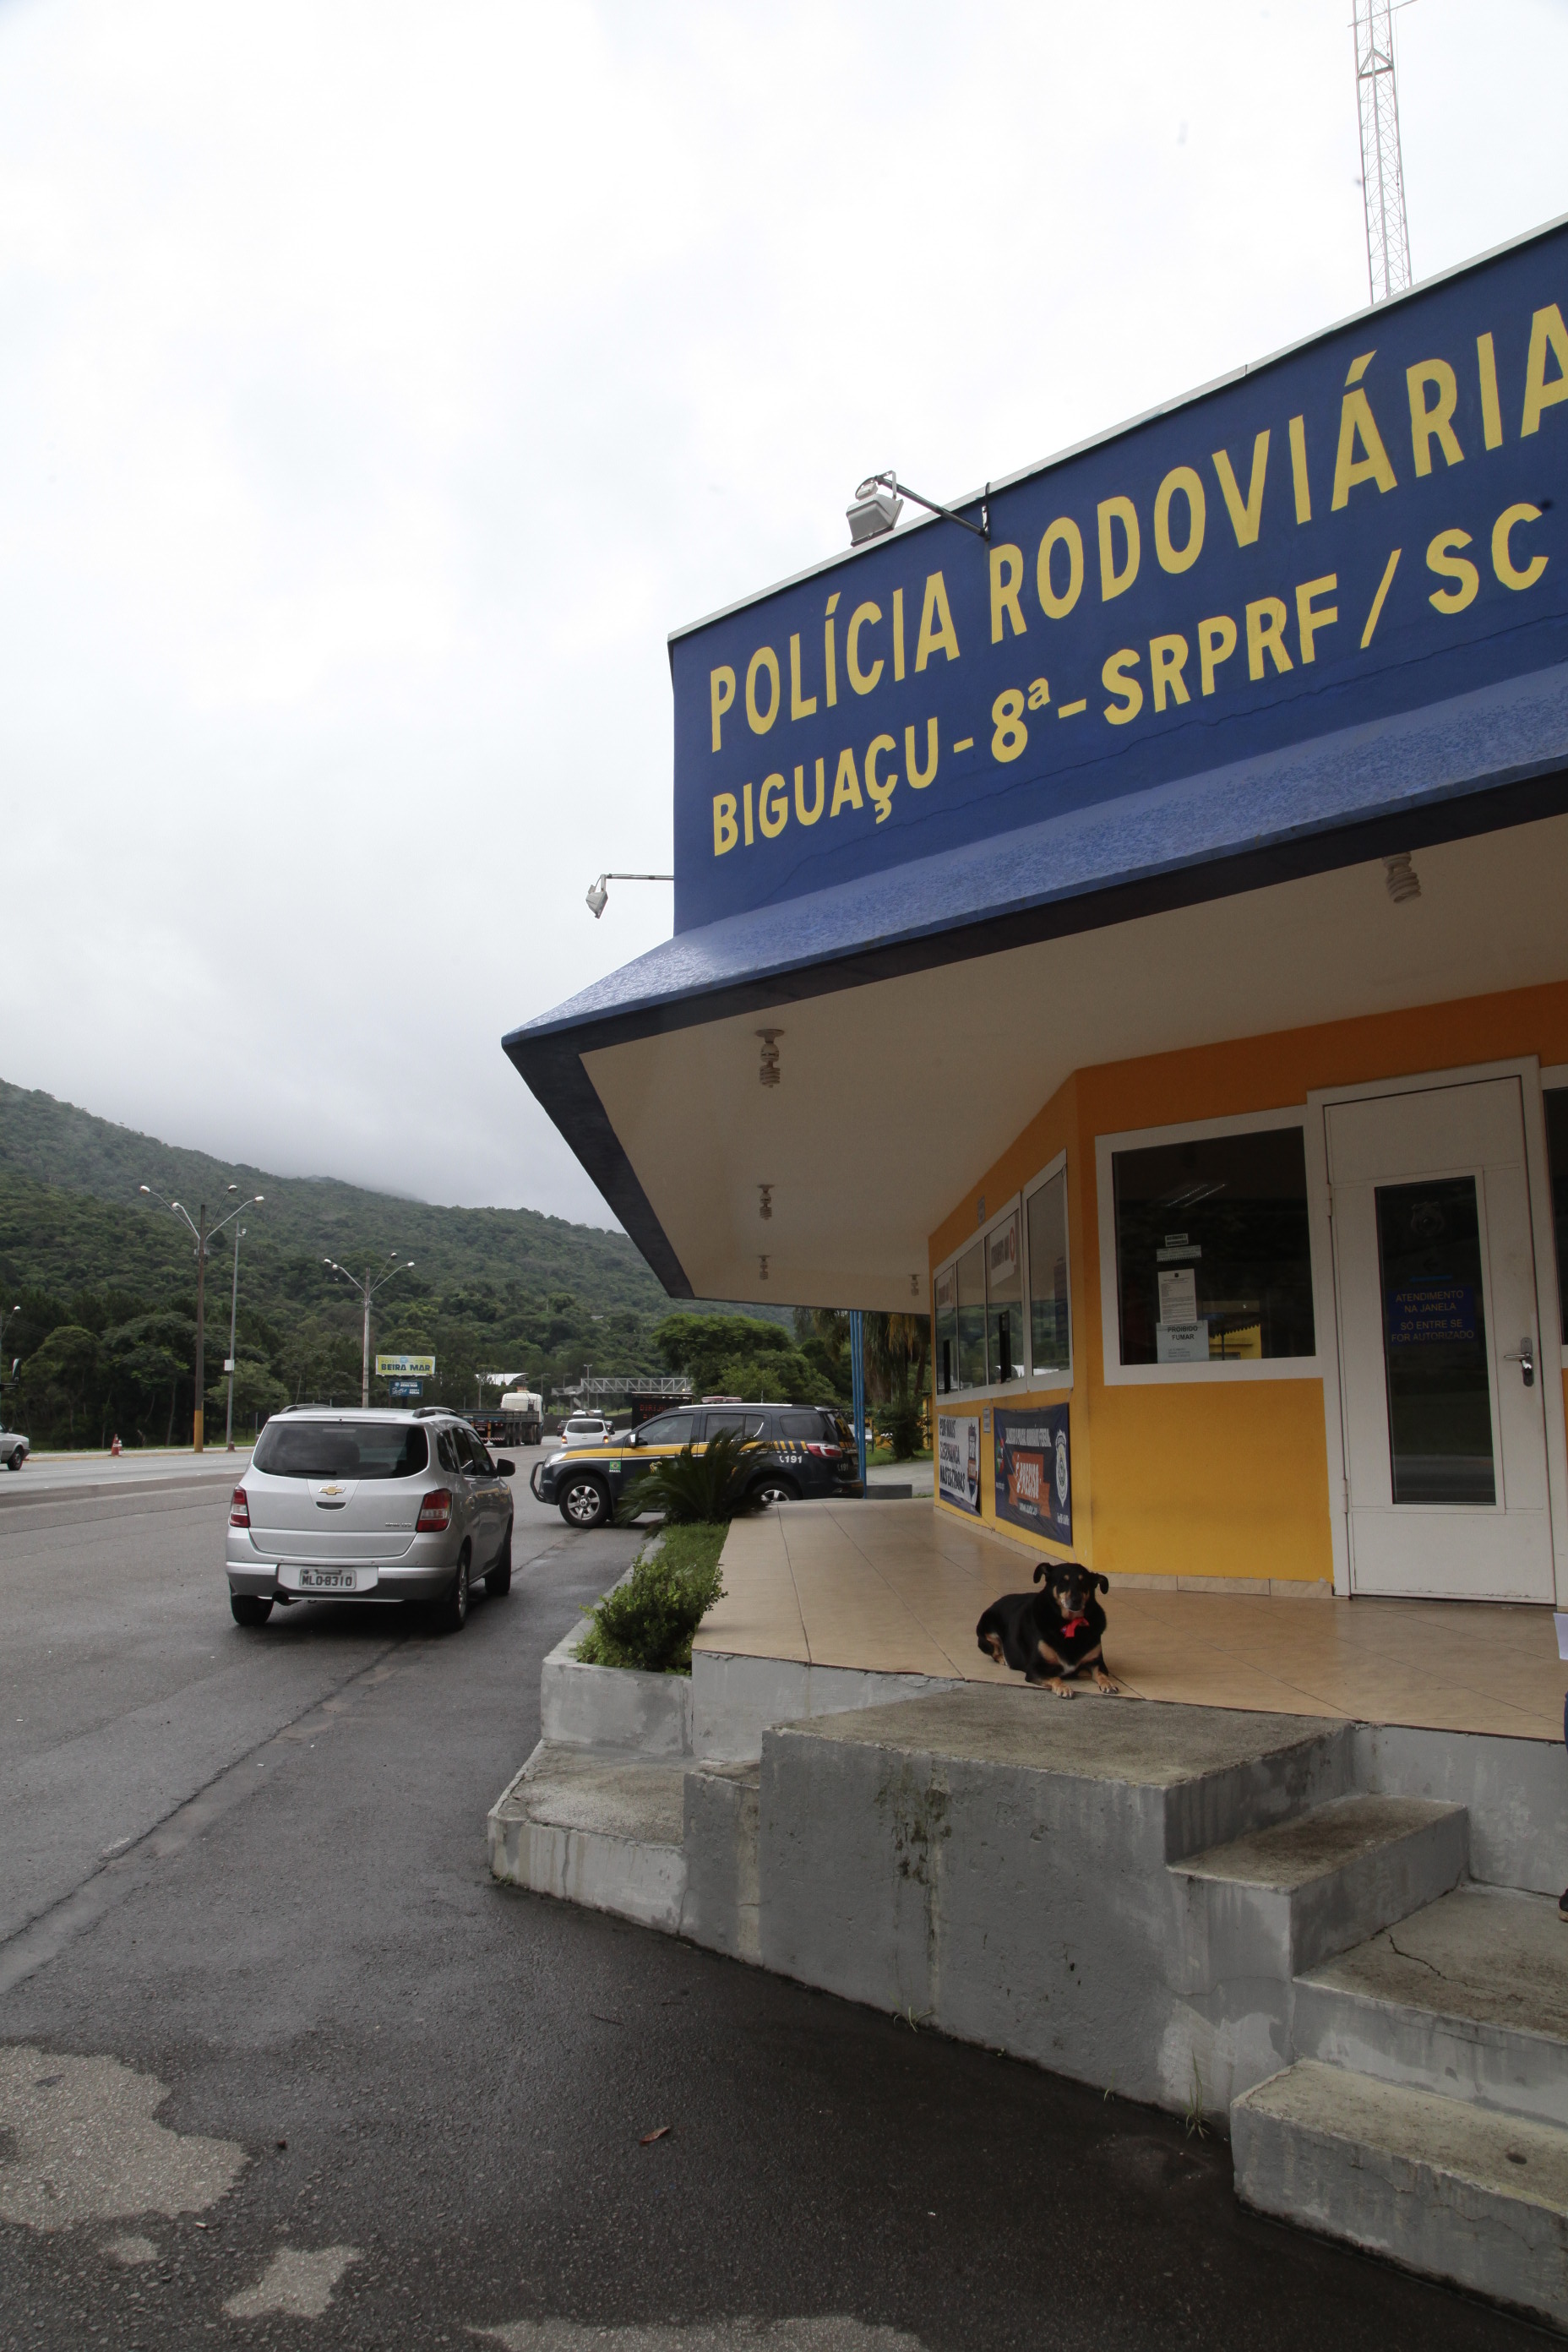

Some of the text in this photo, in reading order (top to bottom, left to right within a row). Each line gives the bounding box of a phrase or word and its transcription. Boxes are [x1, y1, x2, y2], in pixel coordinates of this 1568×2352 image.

[711, 304, 1568, 753] POLÍCIA RODOVIÁRIA
[714, 717, 938, 855] BIGUAÇU
[1102, 574, 1338, 724] SRPRF
[1427, 504, 1549, 614] SC
[1396, 1290, 1464, 1303] ATENDIMENTO
[1420, 1303, 1456, 1312] JANELA
[1400, 1319, 1462, 1331] SÓ ENTRE SE
[1391, 1330, 1474, 1342] FOR AUTORIZADO
